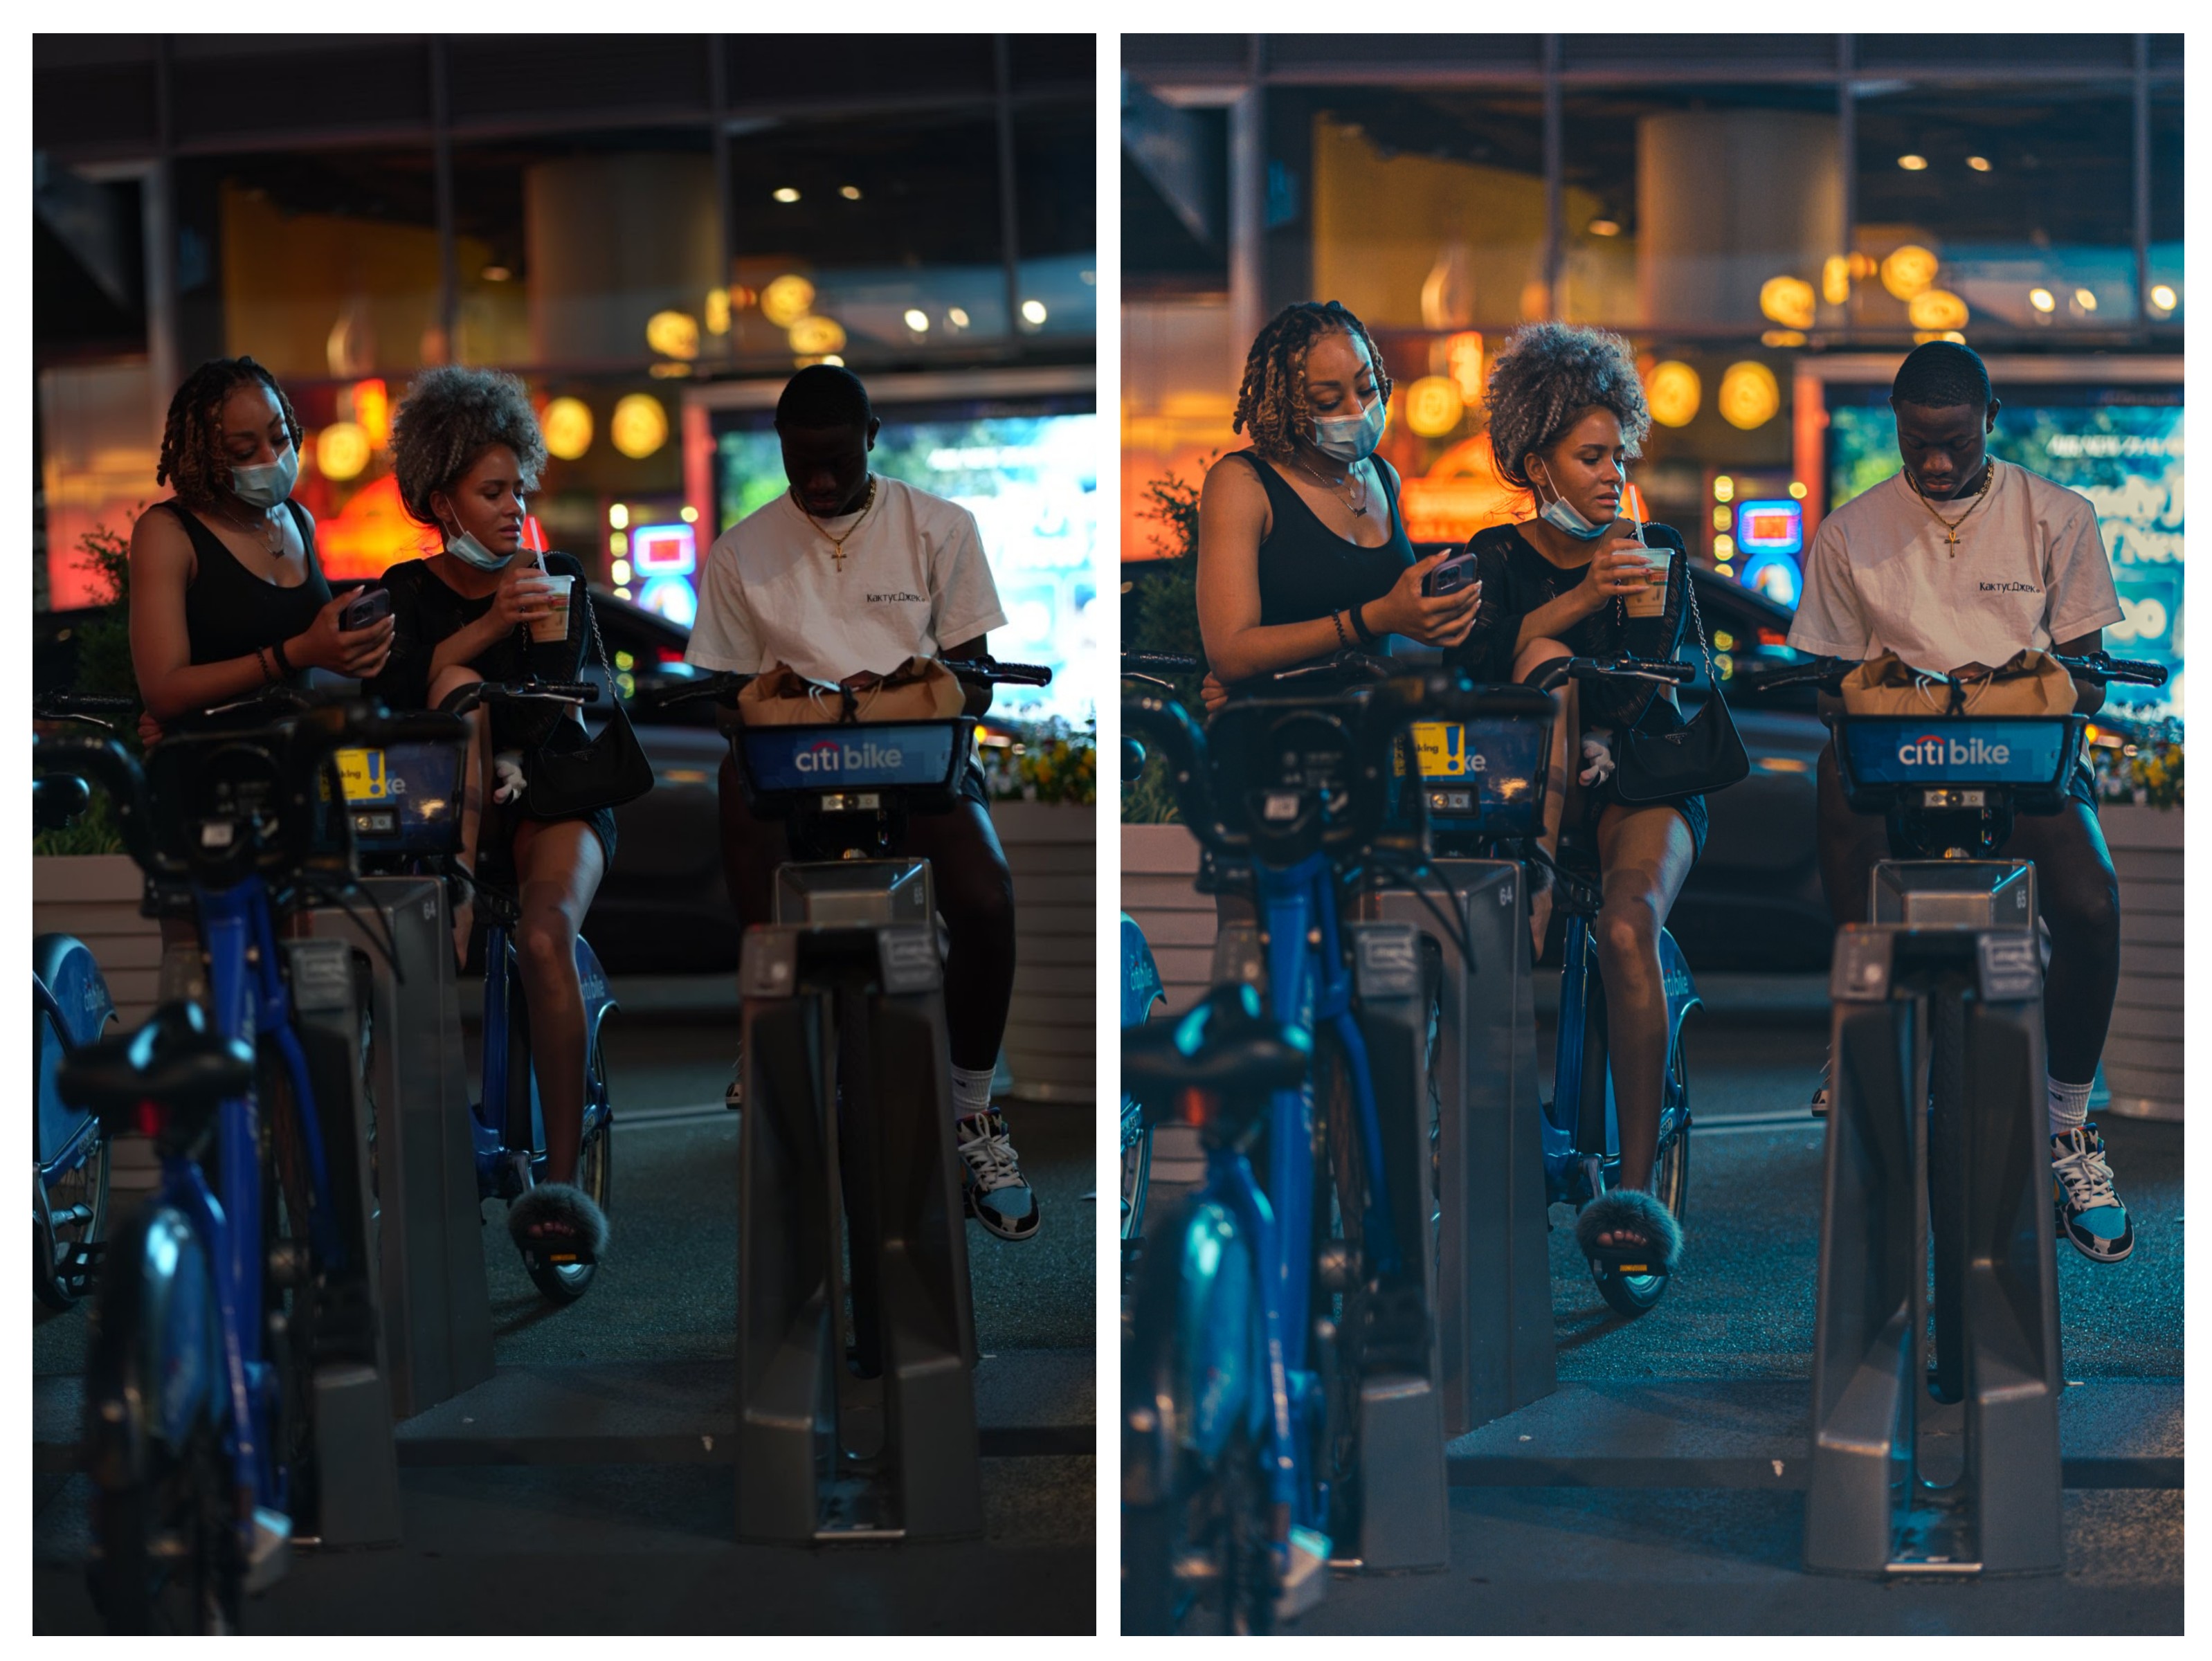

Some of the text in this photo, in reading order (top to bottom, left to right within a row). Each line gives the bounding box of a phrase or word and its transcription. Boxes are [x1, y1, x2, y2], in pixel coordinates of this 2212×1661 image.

[795, 741, 903, 772] citi bike
[1898, 734, 2011, 765] citi bike
[1499, 886, 1513, 906] 64
[424, 901, 436, 920] 64
